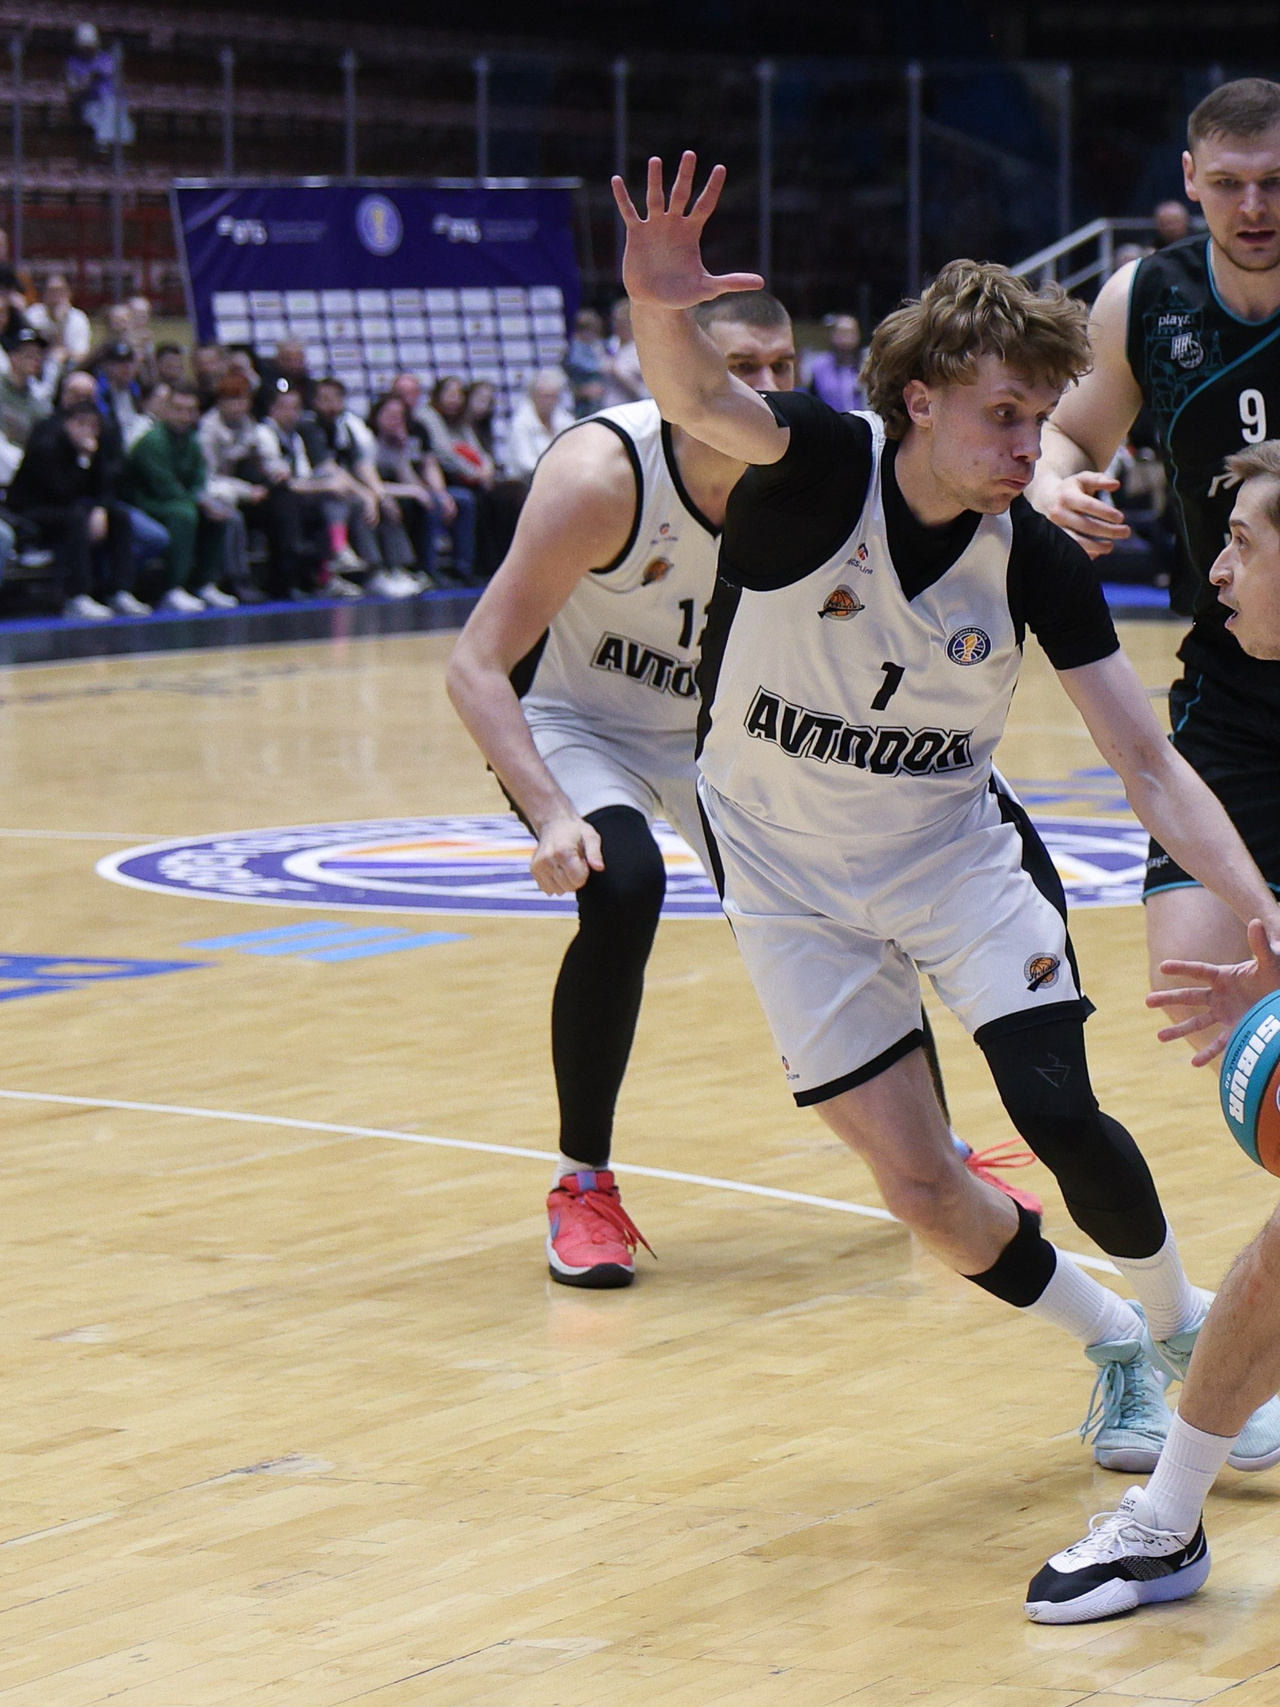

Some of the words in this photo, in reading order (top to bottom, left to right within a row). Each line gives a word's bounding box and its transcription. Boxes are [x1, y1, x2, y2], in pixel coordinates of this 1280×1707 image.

[1238, 388, 1267, 444] 9
[678, 598, 711, 649] 1
[590, 631, 703, 701] AVTO
[870, 661, 905, 711] 1
